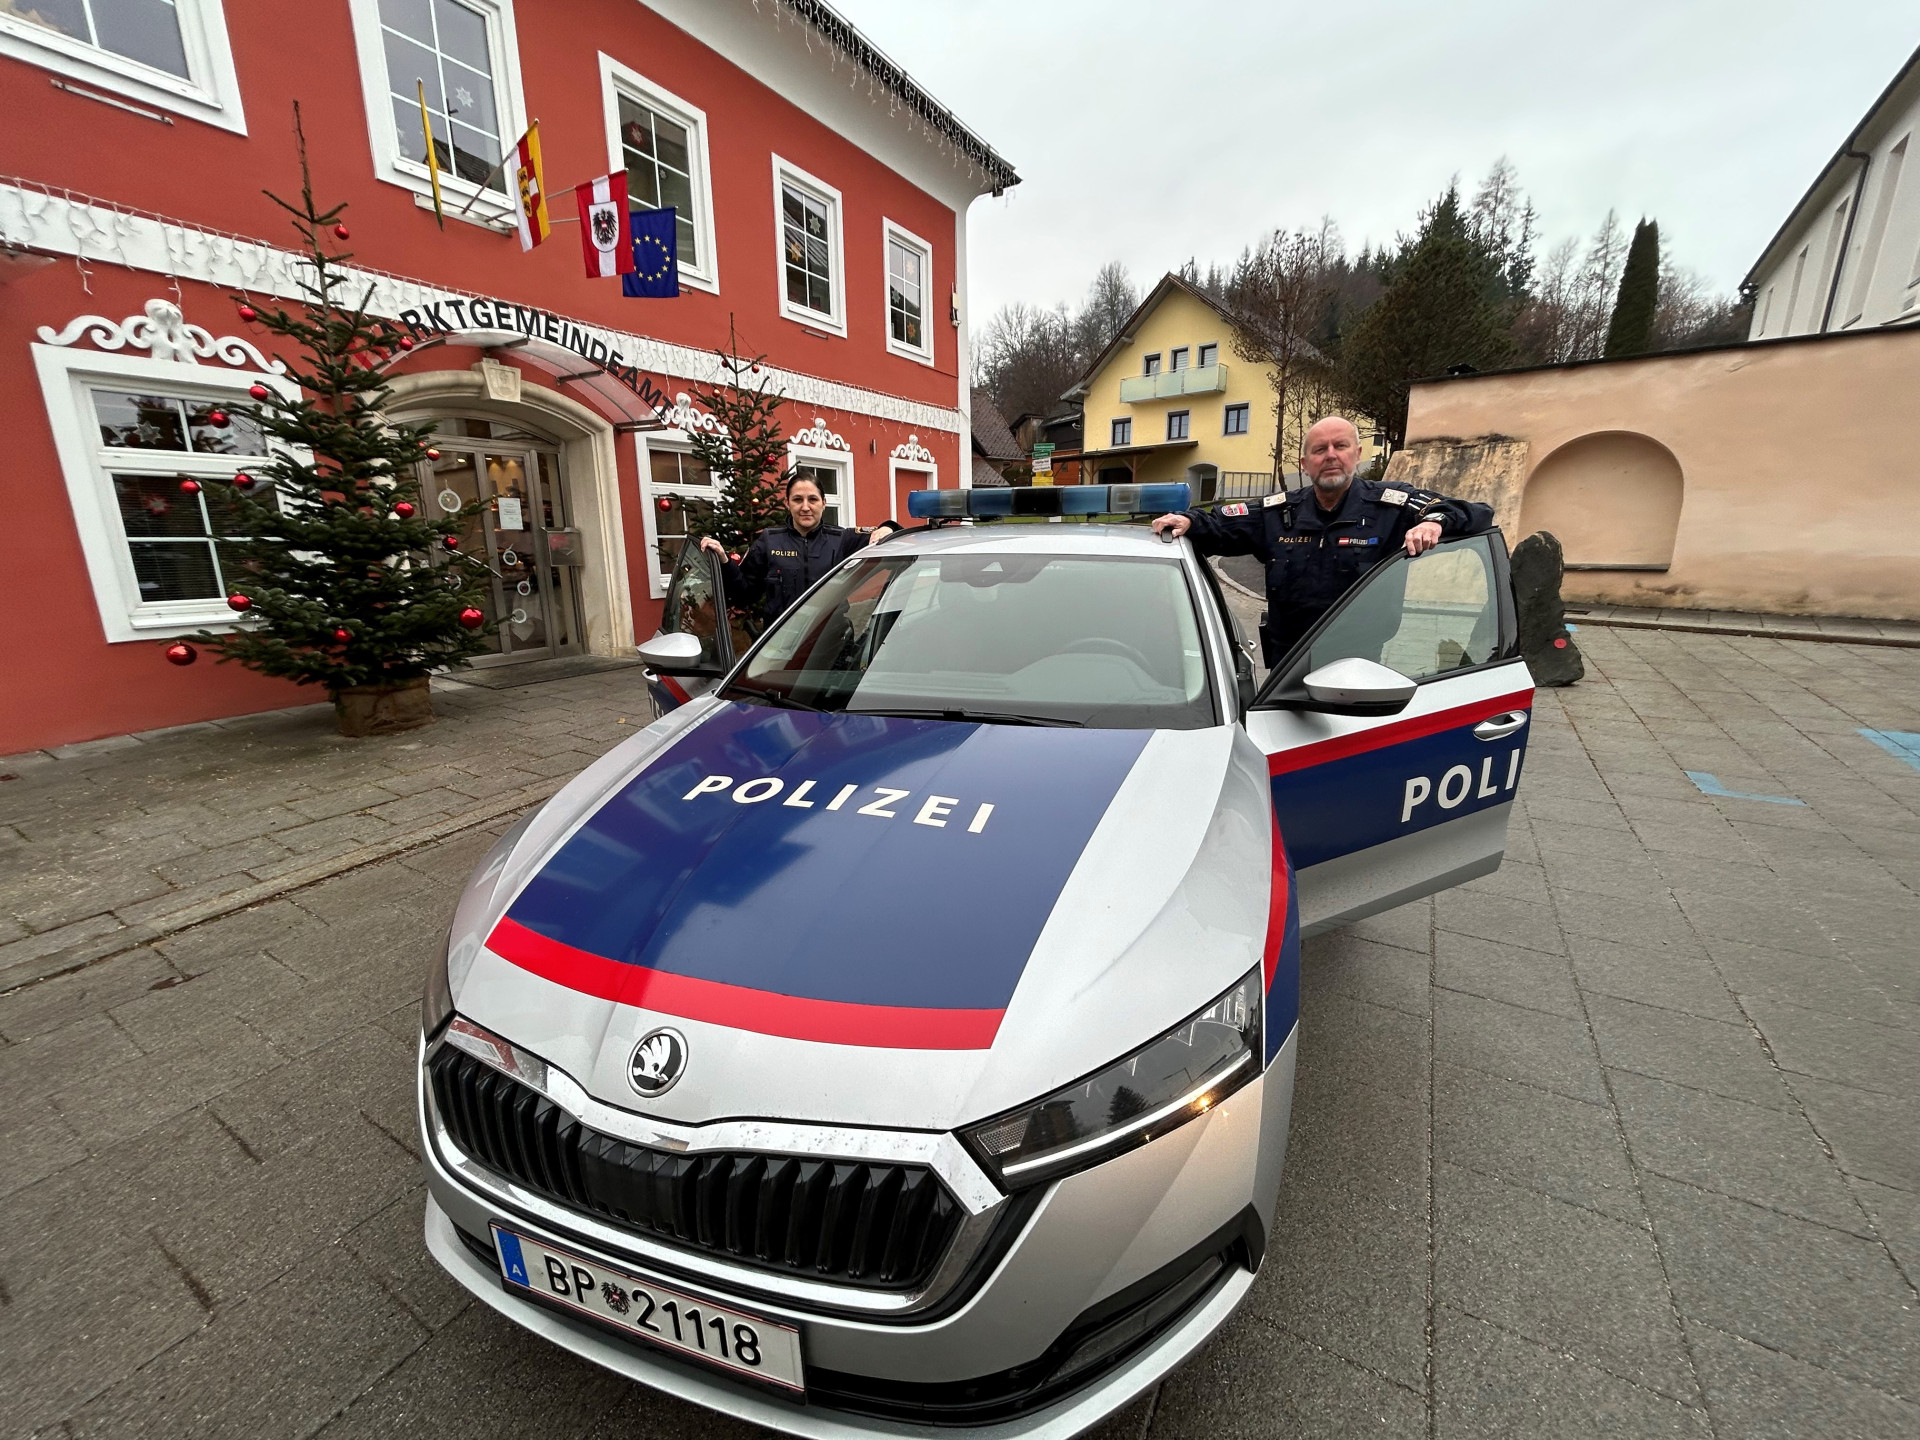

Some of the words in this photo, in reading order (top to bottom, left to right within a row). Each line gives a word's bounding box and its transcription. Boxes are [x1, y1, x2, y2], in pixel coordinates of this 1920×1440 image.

[1278, 535, 1312, 543] POLIZEI
[1349, 537, 1368, 545] POLIZEI
[771, 549, 798, 557] POLIZEI
[1401, 748, 1520, 823] POLI
[681, 775, 995, 834] POLIZEI
[512, 1263, 523, 1277] A
[543, 1254, 595, 1304] BP
[631, 1289, 762, 1366] 21118
